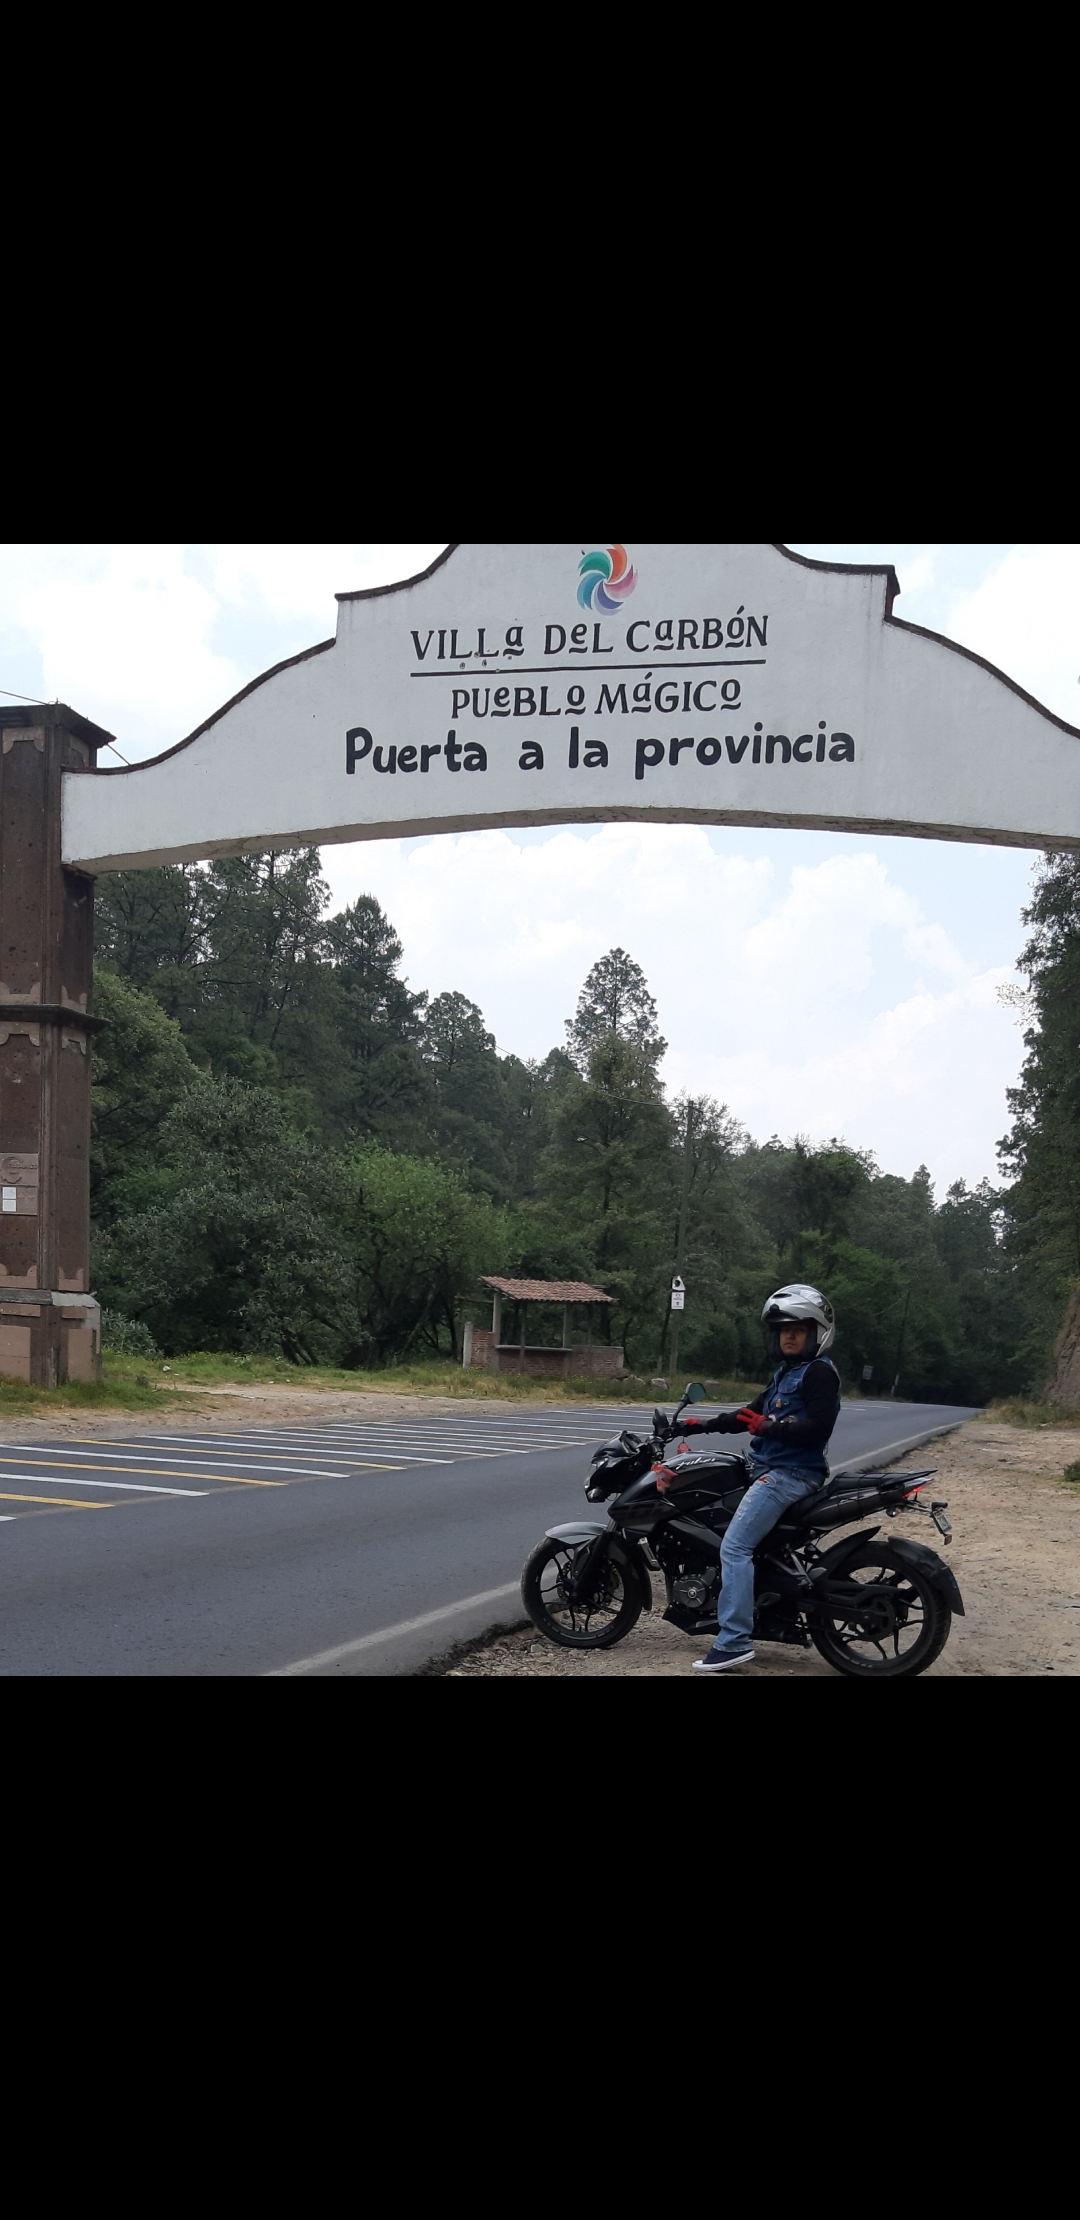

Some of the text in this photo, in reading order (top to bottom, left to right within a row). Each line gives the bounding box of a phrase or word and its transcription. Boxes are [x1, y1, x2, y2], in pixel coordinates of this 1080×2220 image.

[345, 720, 855, 781] Puerta a la provincia
